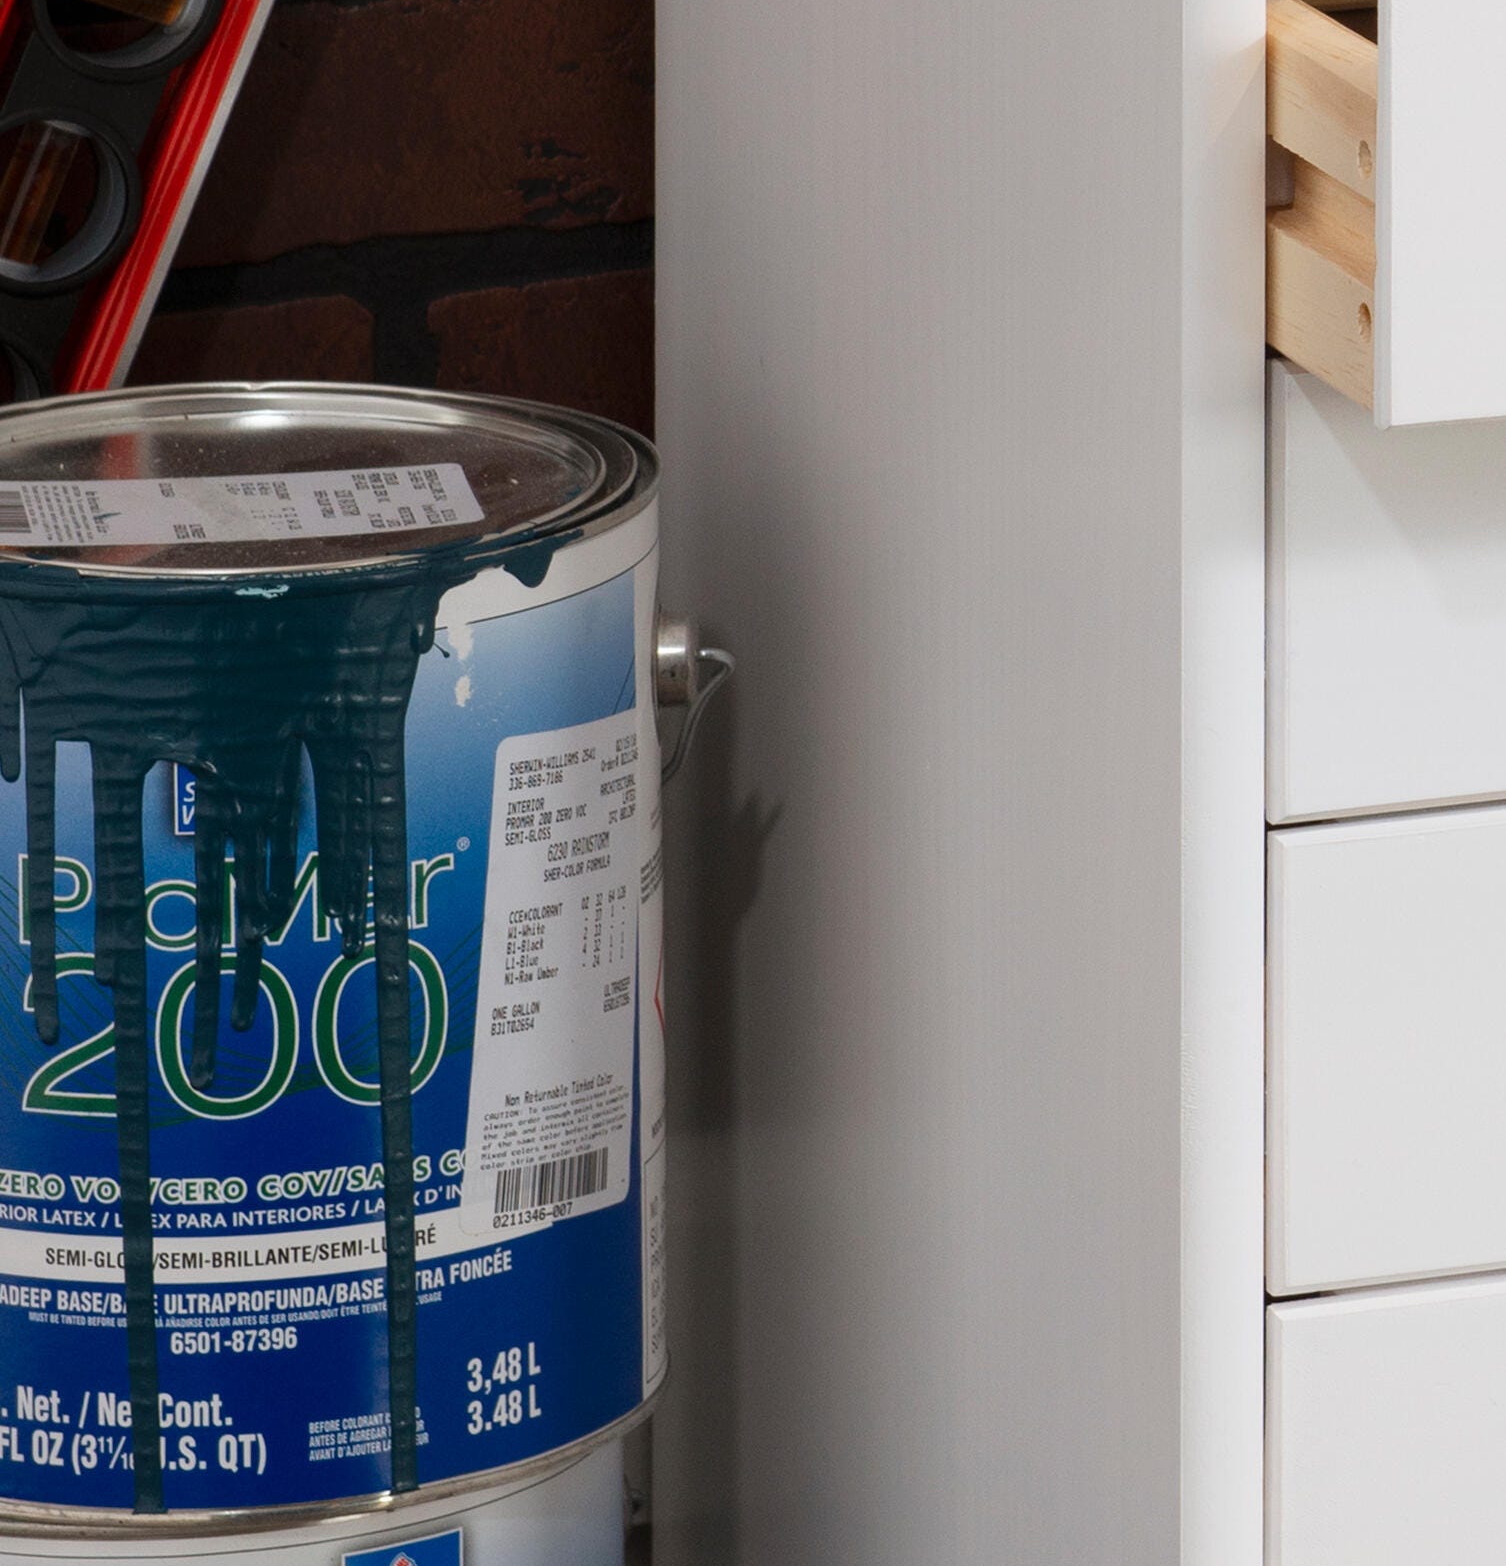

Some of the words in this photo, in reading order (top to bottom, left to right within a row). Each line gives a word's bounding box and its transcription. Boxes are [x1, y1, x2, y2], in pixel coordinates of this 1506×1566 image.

[508, 797, 545, 815] INTERIOR
[505, 826, 551, 846] SEMI-GLOSS
[22, 938, 448, 1120] 200
[492, 1006, 508, 1020] ONE
[512, 1001, 541, 1018] GALLON
[0, 1170, 65, 1200] ZERO
[70, 1174, 247, 1205] VO/CERO
[257, 1156, 431, 1201] COV/SAS
[42, 1209, 96, 1227] LATEX
[177, 1213, 226, 1228] PARA
[233, 1202, 345, 1227] INTERIORES
[493, 1202, 573, 1229] 0211346-007
[450, 1248, 513, 1285] FONCÉE
[171, 1326, 297, 1355] 6501-87396
[467, 1347, 522, 1395] 3,48
[528, 1342, 541, 1376] L
[17, 1385, 70, 1424] Net.
[158, 1392, 233, 1428] Cont.
[467, 1389, 522, 1435] 3.48
[529, 1384, 541, 1418] L
[32, 1429, 64, 1466] OZ
[218, 1433, 267, 1475] QT)
